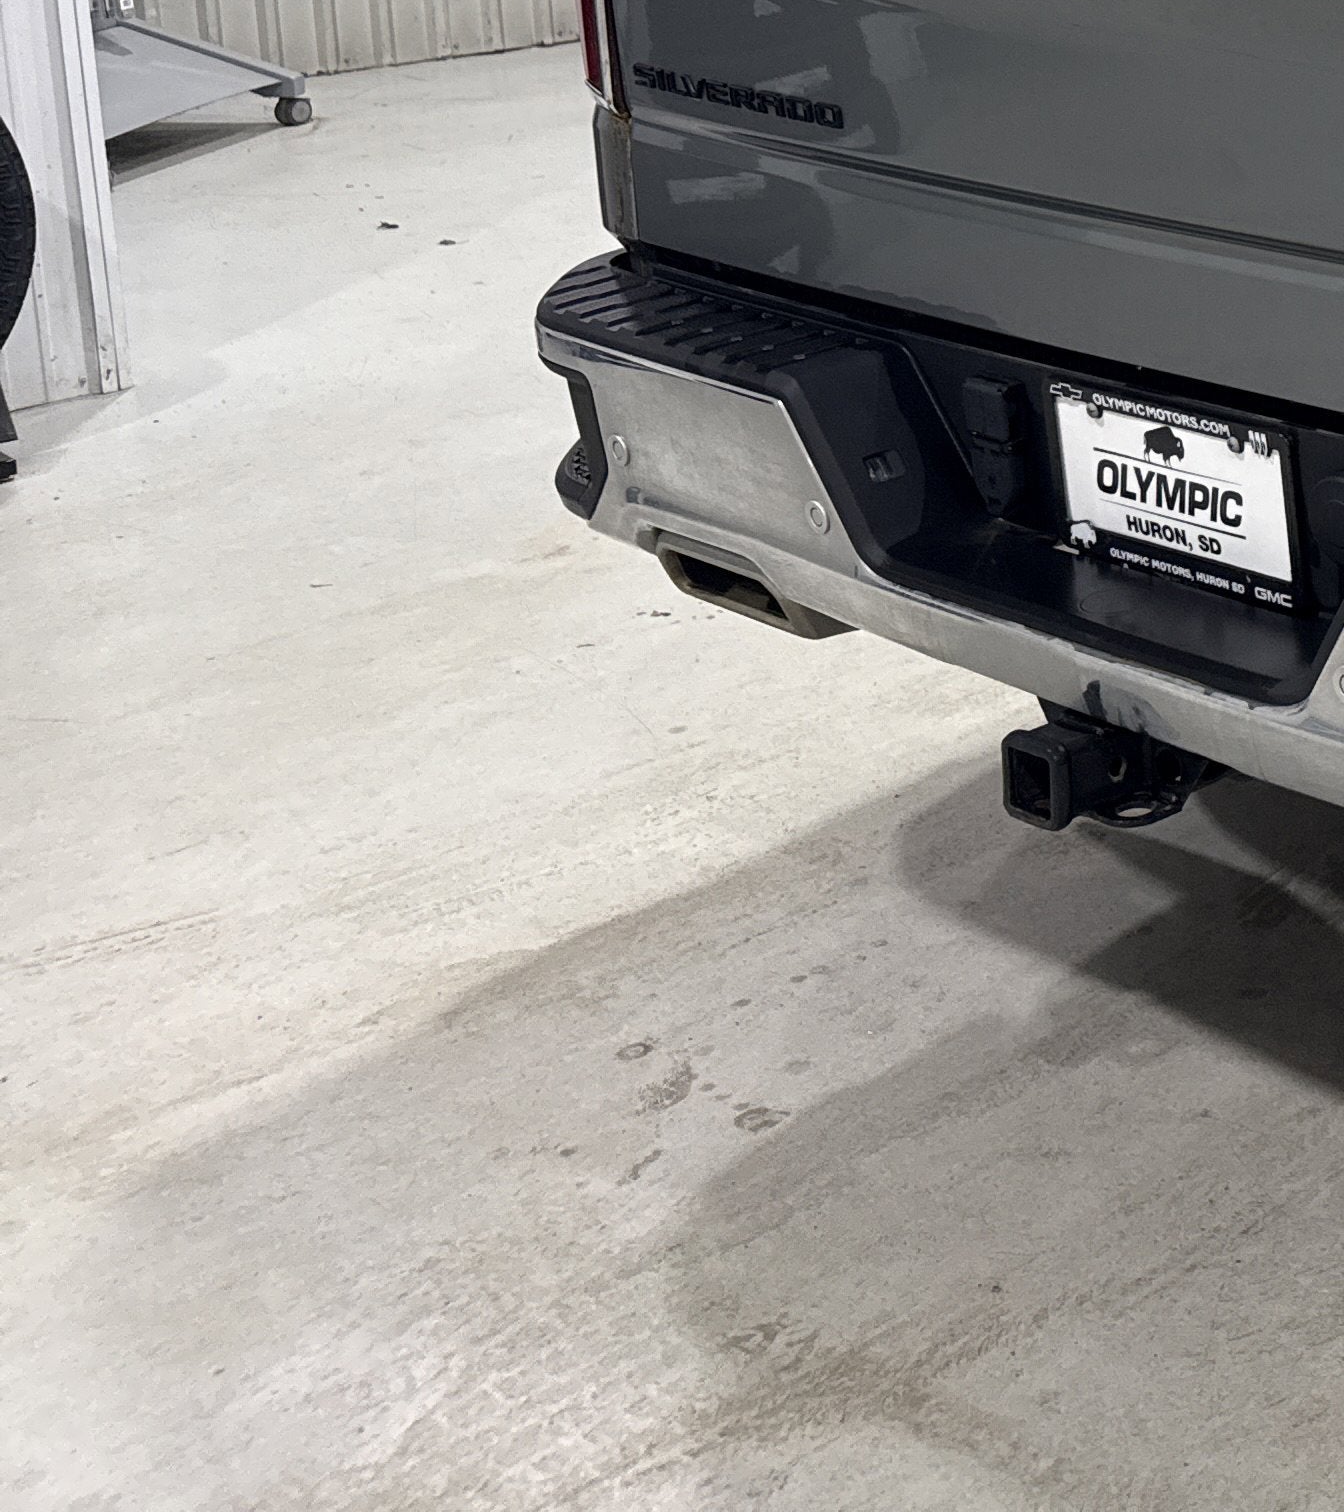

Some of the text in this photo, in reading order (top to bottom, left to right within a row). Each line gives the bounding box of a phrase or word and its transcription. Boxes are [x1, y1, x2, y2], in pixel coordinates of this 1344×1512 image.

[632, 62, 844, 130] SILVERADO
[1092, 393, 1230, 437] OLYMPICMOTORS.COM
[1096, 458, 1243, 528] OLYMPIC
[1126, 514, 1222, 555] HURON, SD
[1109, 547, 1245, 594] OLYMPIC MOTORS, HURON SD
[1254, 586, 1292, 608] GMC
